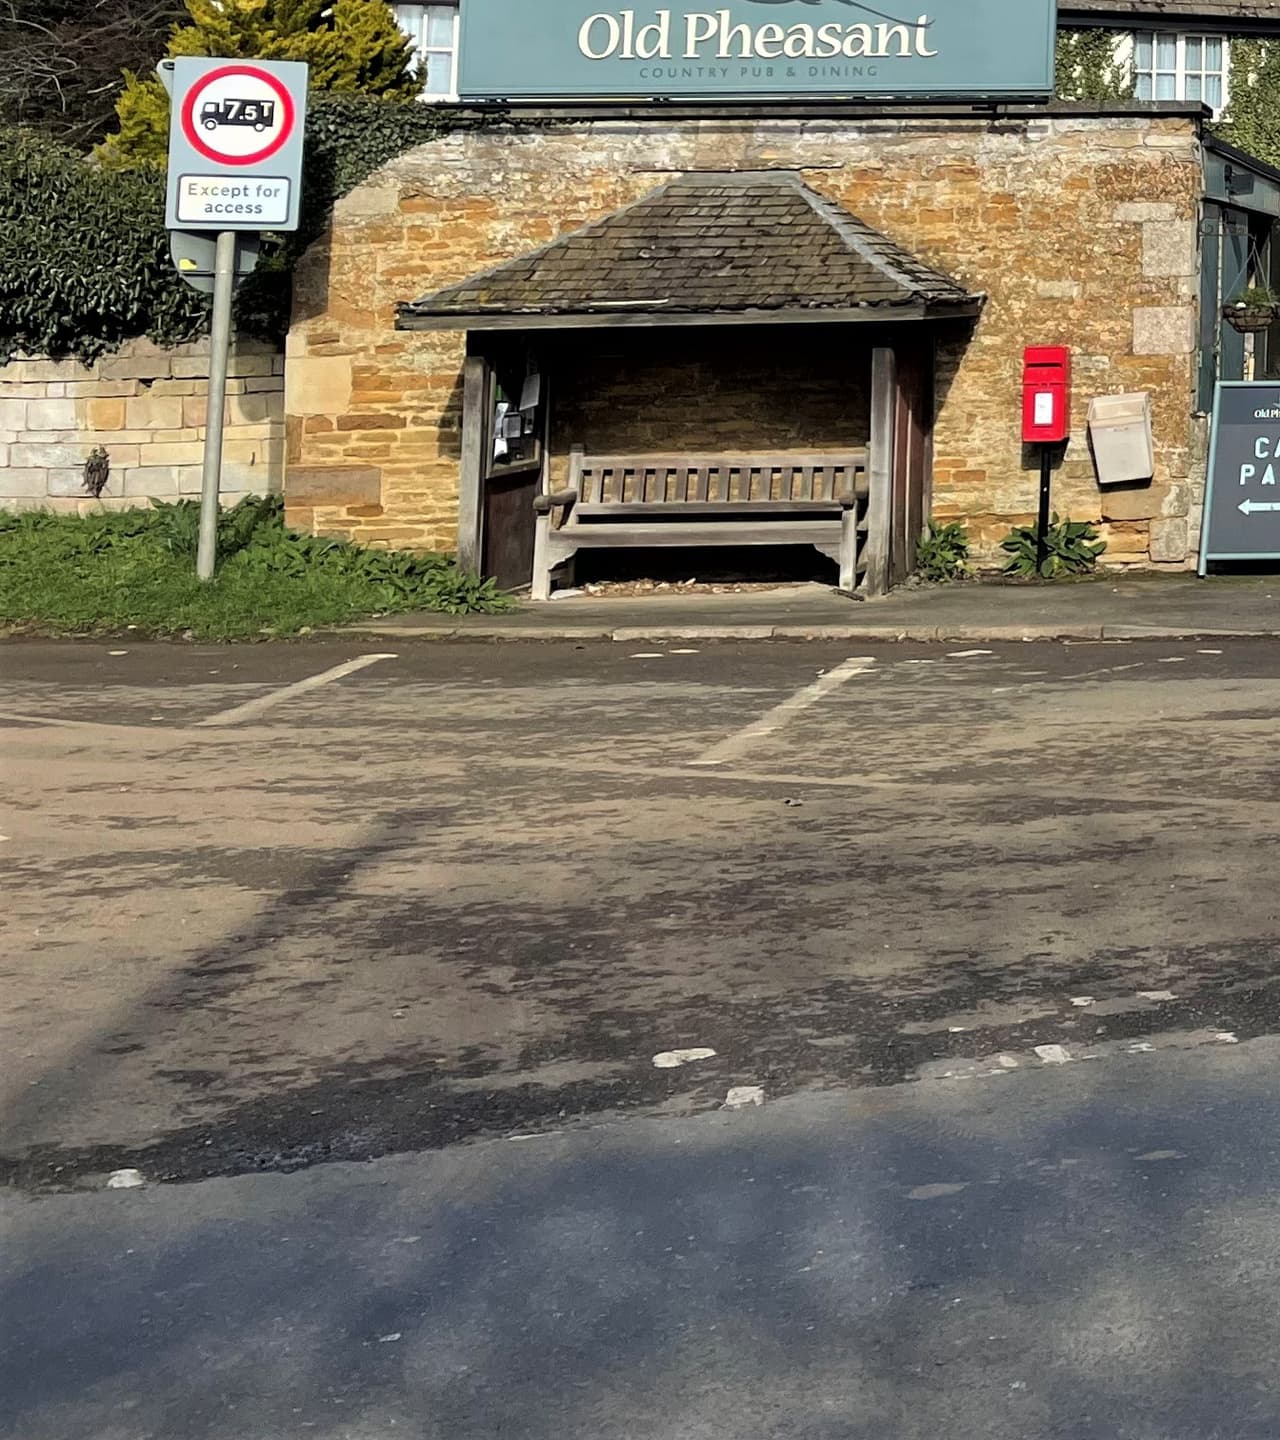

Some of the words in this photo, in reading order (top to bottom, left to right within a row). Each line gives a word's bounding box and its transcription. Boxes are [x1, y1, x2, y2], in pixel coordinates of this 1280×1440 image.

[578, 10, 672, 60] Old
[682, 9, 938, 59] Pheasant
[639, 67, 729, 79] COUNTRY
[740, 66, 775, 78] PUB
[786, 66, 796, 78] &
[808, 65, 878, 78] DINING
[188, 182, 250, 199] Except
[256, 184, 281, 198] for
[204, 203, 263, 214] access
[1254, 409, 1270, 418] Old
